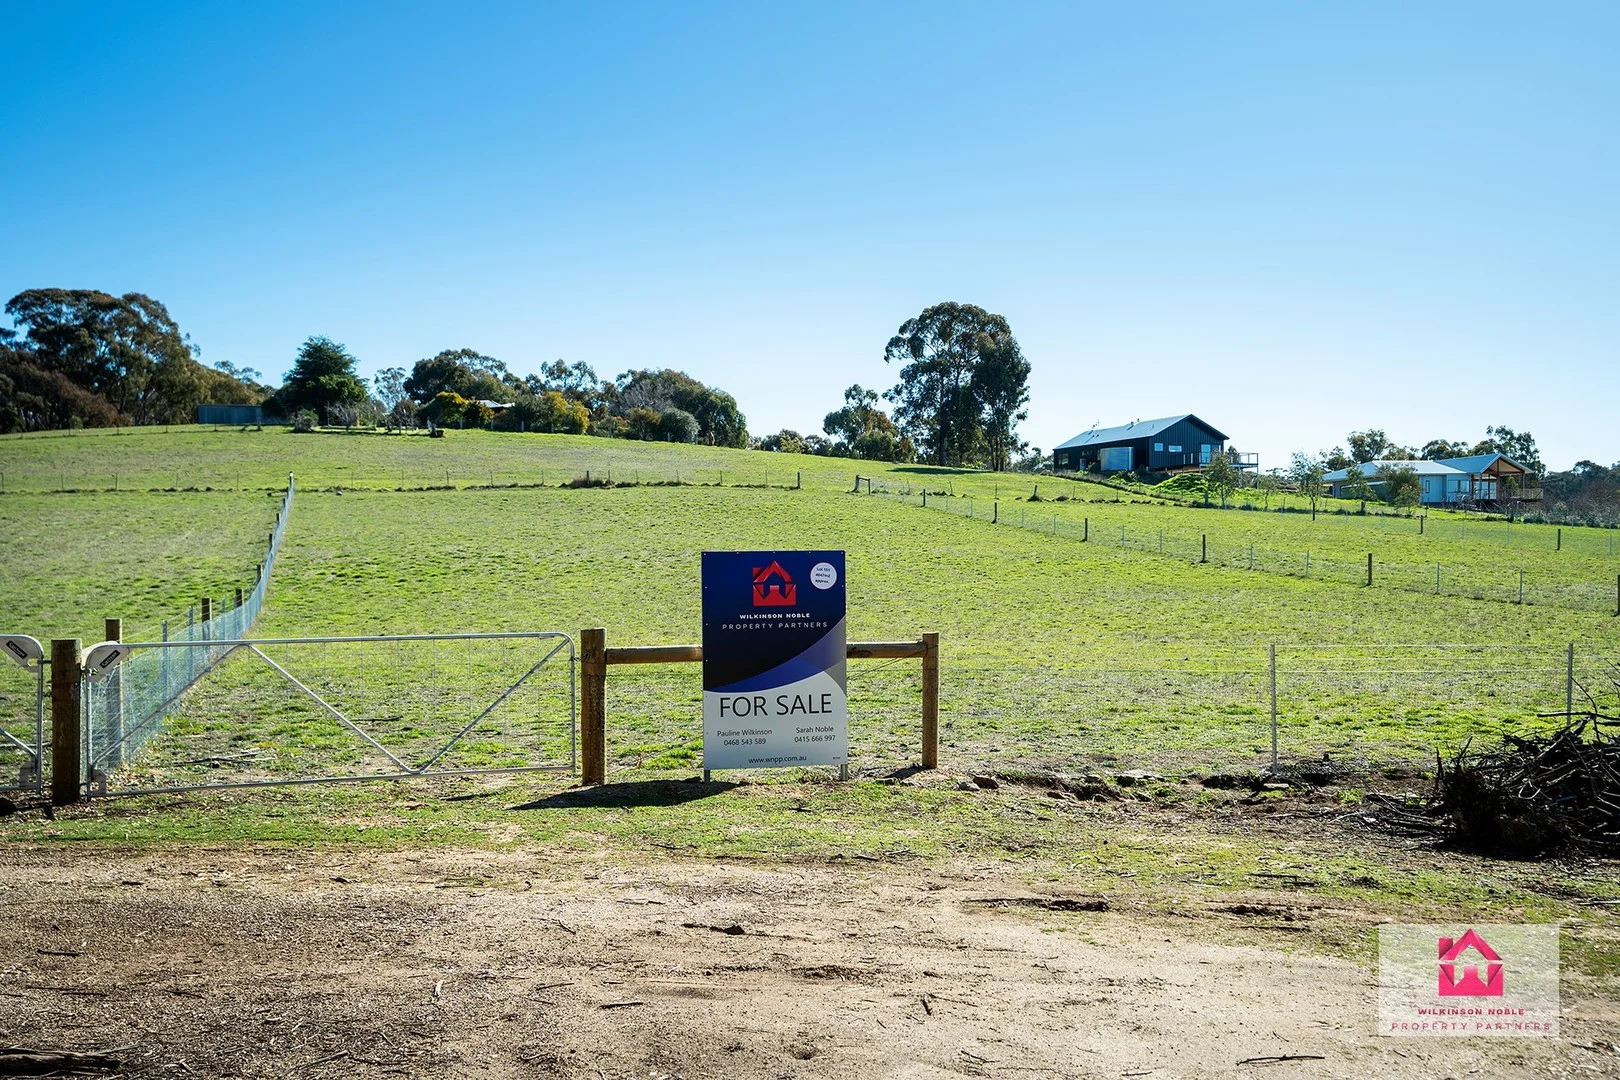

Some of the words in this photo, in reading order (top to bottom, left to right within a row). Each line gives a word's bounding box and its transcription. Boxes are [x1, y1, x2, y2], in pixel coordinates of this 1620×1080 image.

[720, 696, 768, 717] FOR
[776, 694, 832, 716] SALE
[748, 756, 806, 764] www.wnpp.com.au
